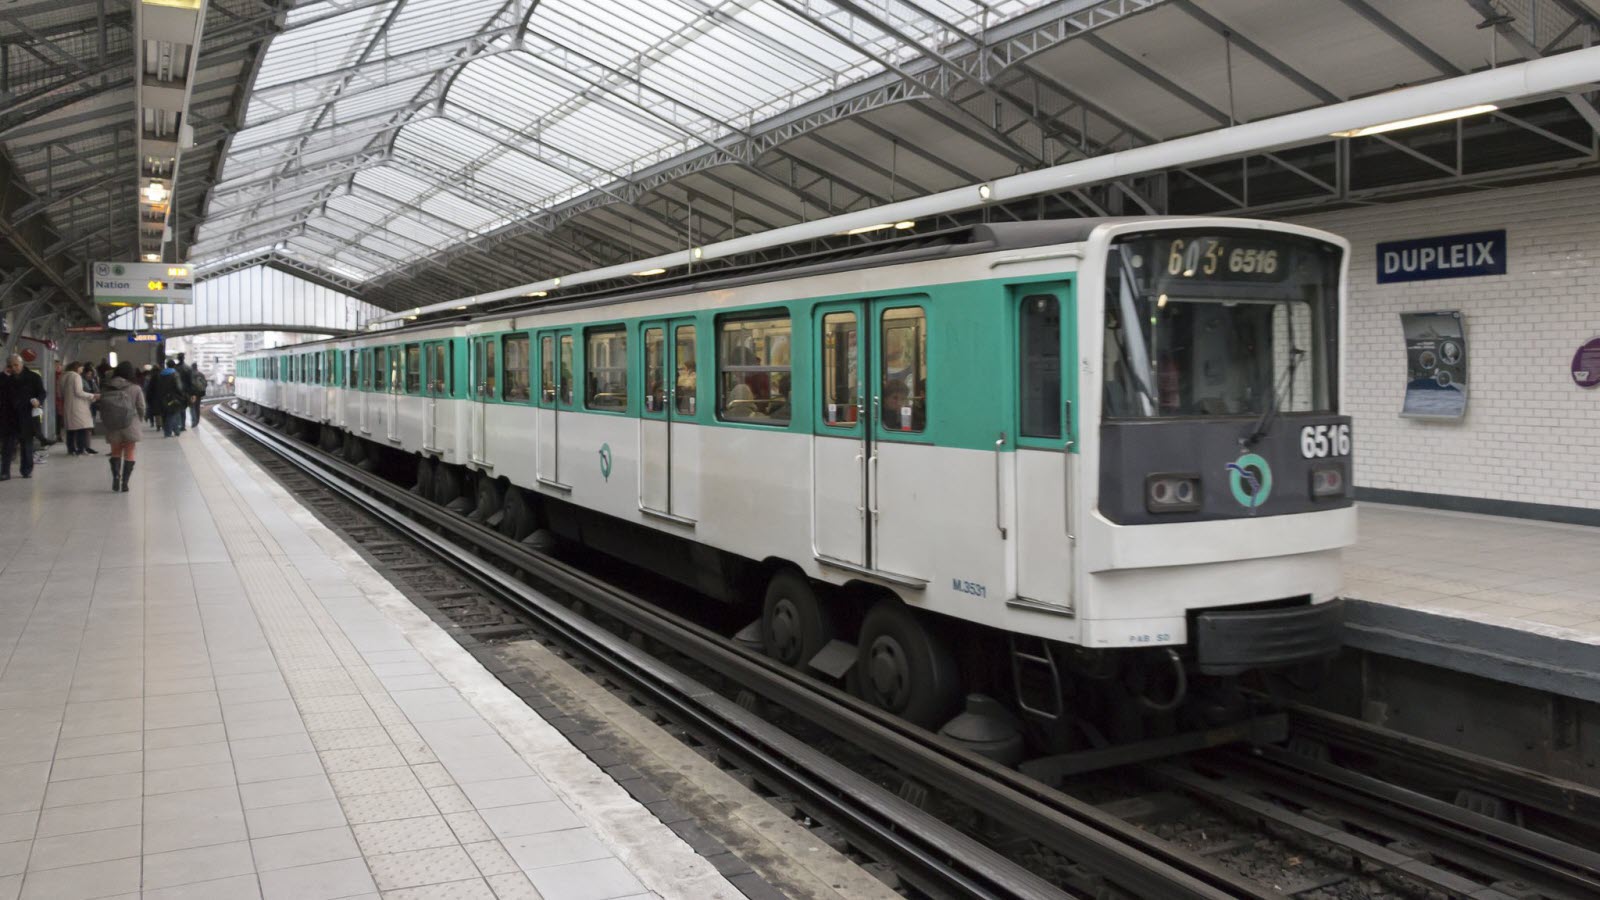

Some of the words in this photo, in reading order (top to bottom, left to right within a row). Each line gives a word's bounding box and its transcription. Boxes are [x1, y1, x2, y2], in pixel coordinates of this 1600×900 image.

[1229, 248, 1278, 274] 6516
[1384, 241, 1495, 274] DUPLEIX
[96, 281, 130, 289] Nation
[1301, 424, 1350, 459] 6516
